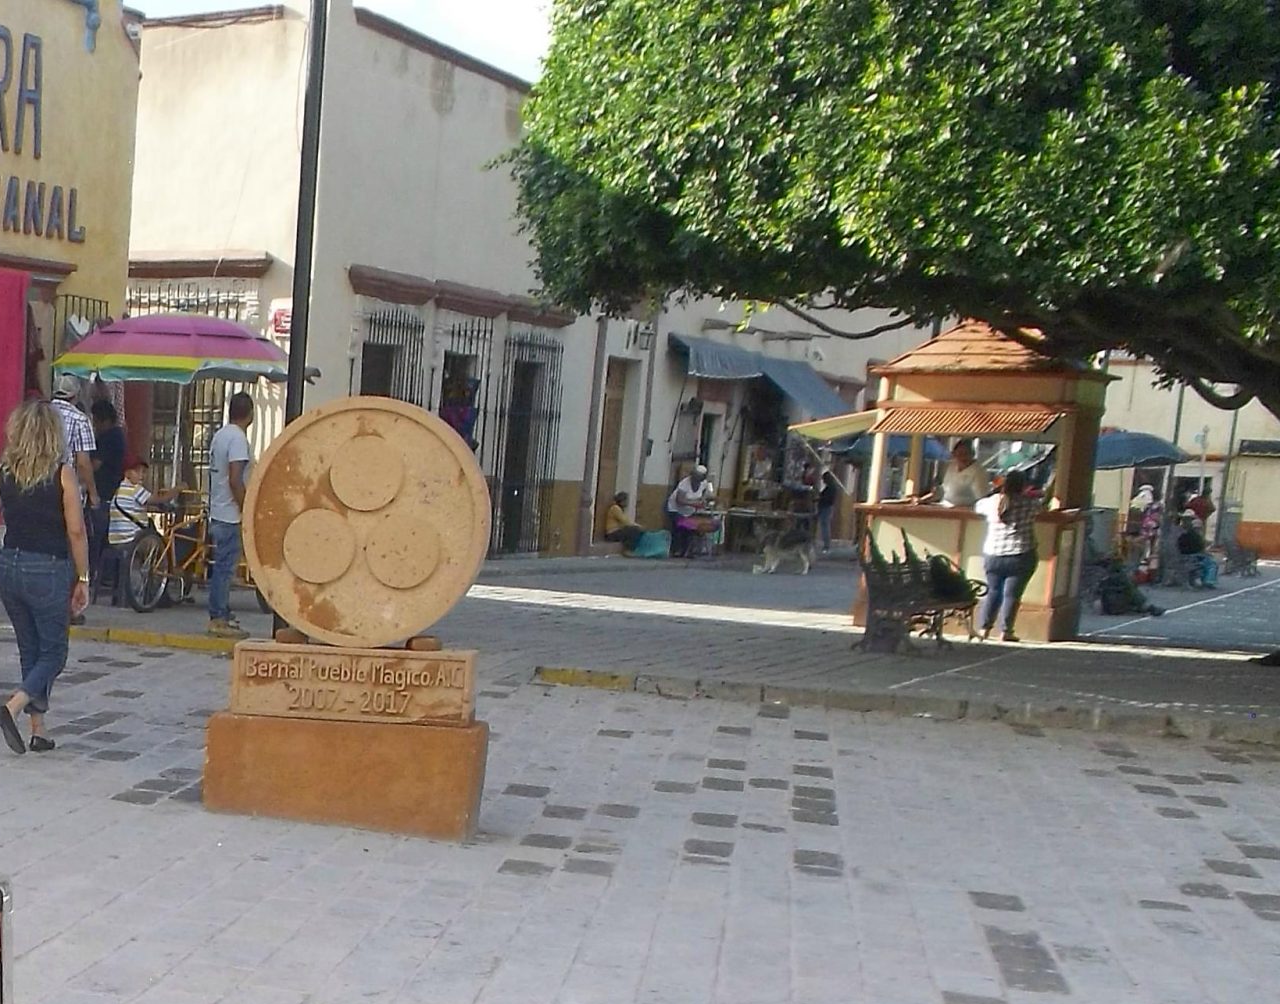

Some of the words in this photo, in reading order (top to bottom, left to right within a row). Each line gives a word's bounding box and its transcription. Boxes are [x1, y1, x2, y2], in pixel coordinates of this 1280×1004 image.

[245, 657, 303, 679] Bernal
[308, 658, 367, 683] Pueblo
[360, 690, 412, 714] 2017
